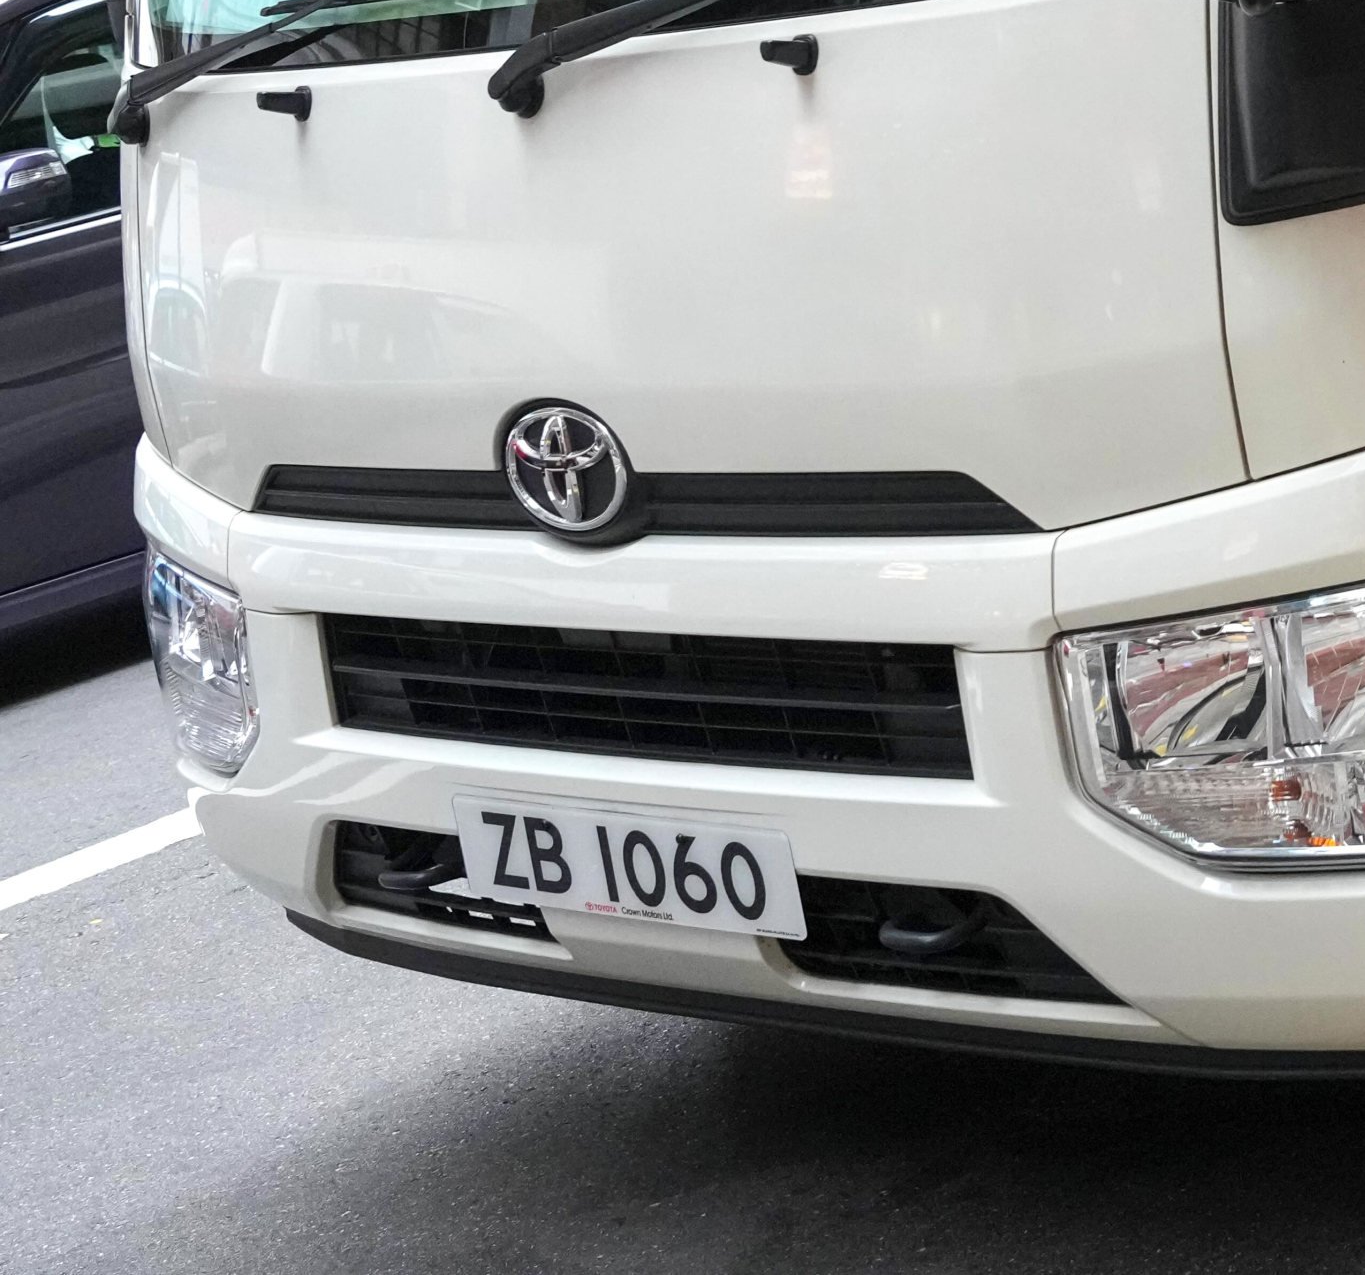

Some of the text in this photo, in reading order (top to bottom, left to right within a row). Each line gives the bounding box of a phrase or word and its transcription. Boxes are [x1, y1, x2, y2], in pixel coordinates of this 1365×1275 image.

[480, 810, 767, 921] ZB 1060
[593, 903, 674, 921] TOYOTA Crown Motors Ltd.
